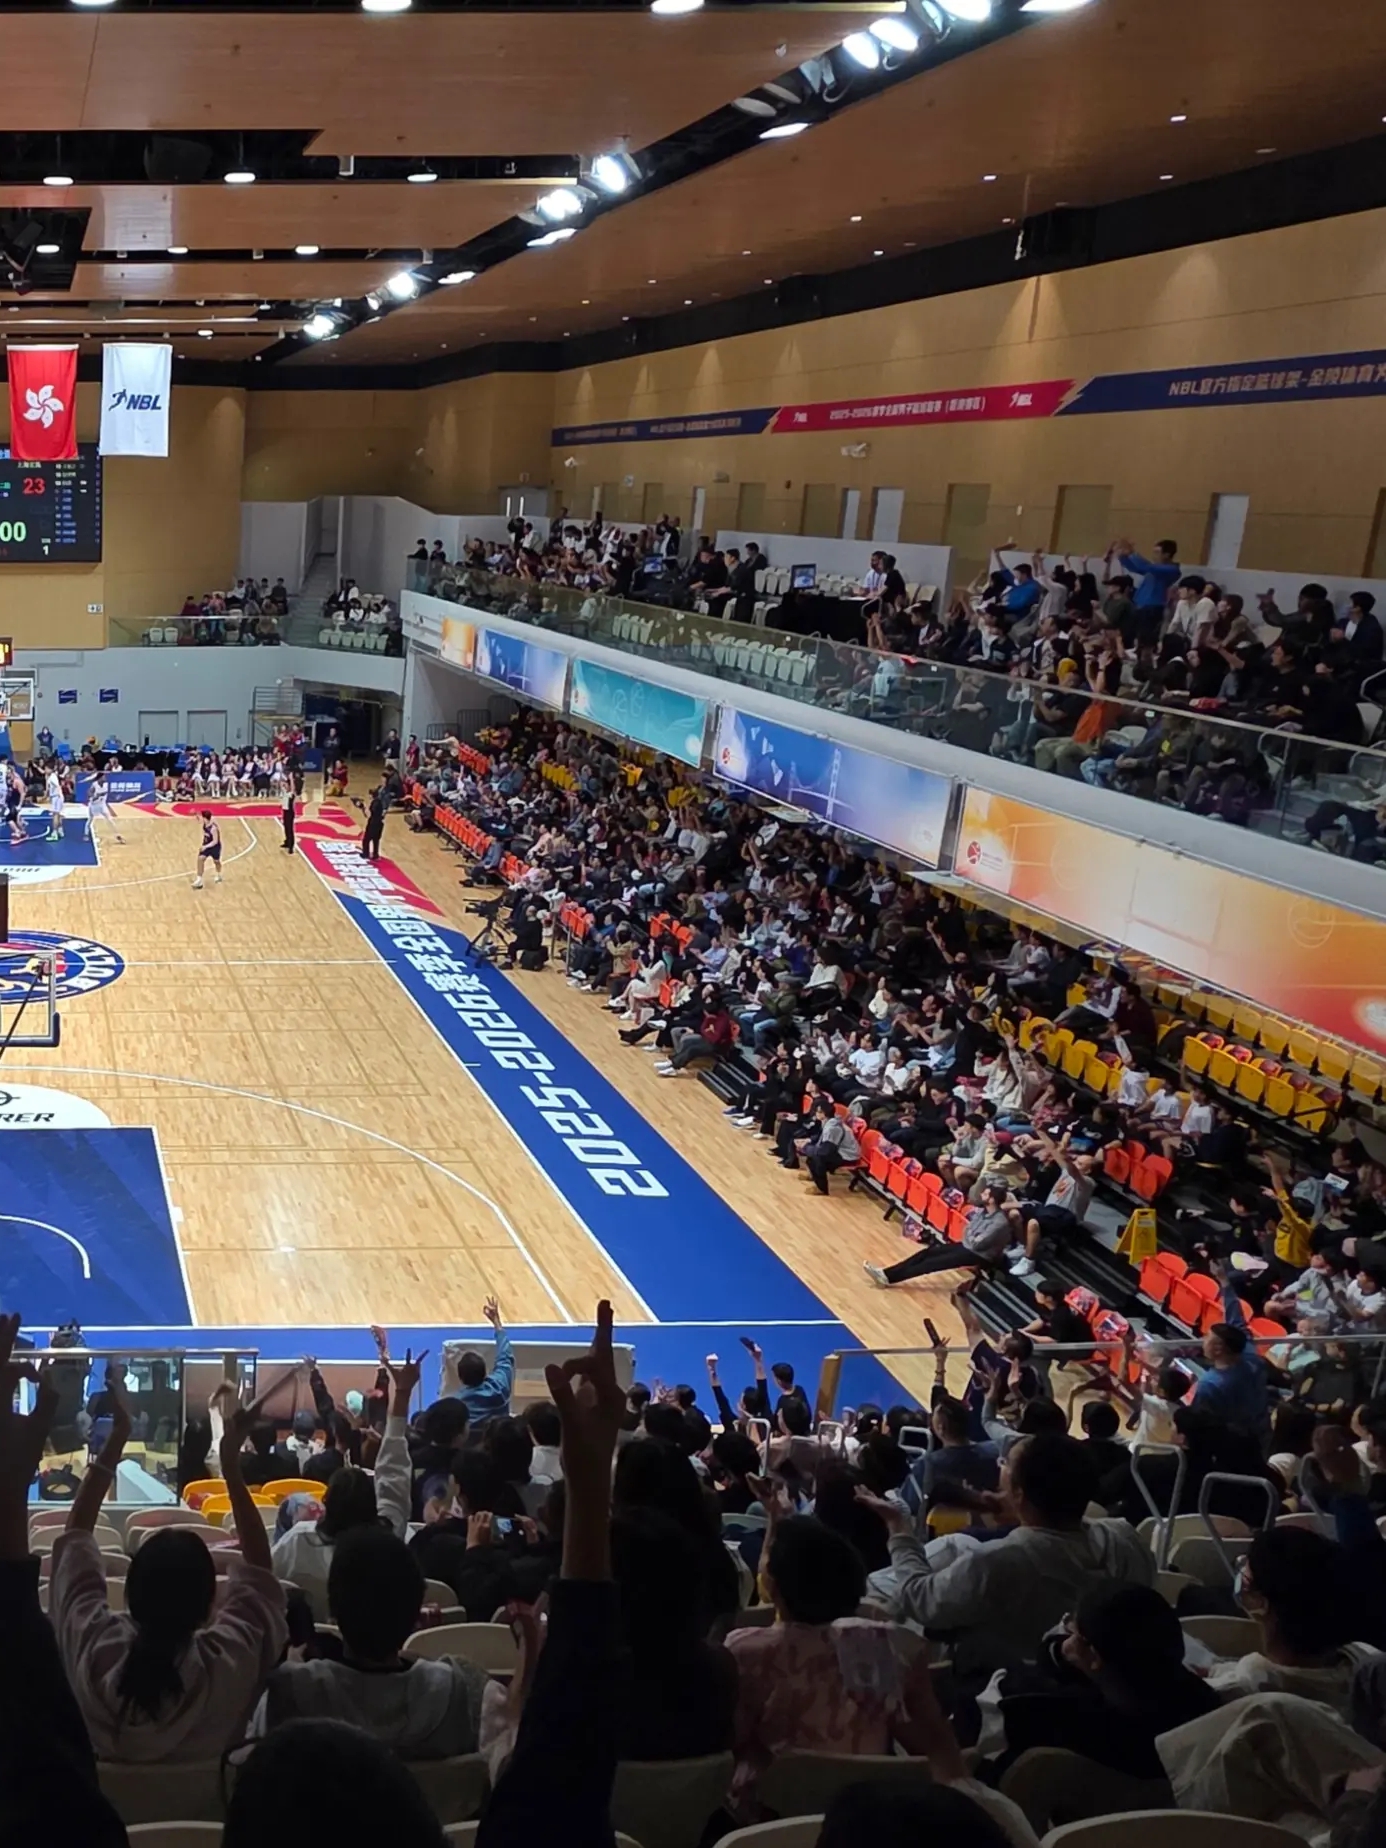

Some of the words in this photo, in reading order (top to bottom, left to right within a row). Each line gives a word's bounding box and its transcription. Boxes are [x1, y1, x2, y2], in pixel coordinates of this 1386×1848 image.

[126, 394, 162, 411] NBL
[23, 477, 45, 495] 23
[42, 545, 49, 556] 1
